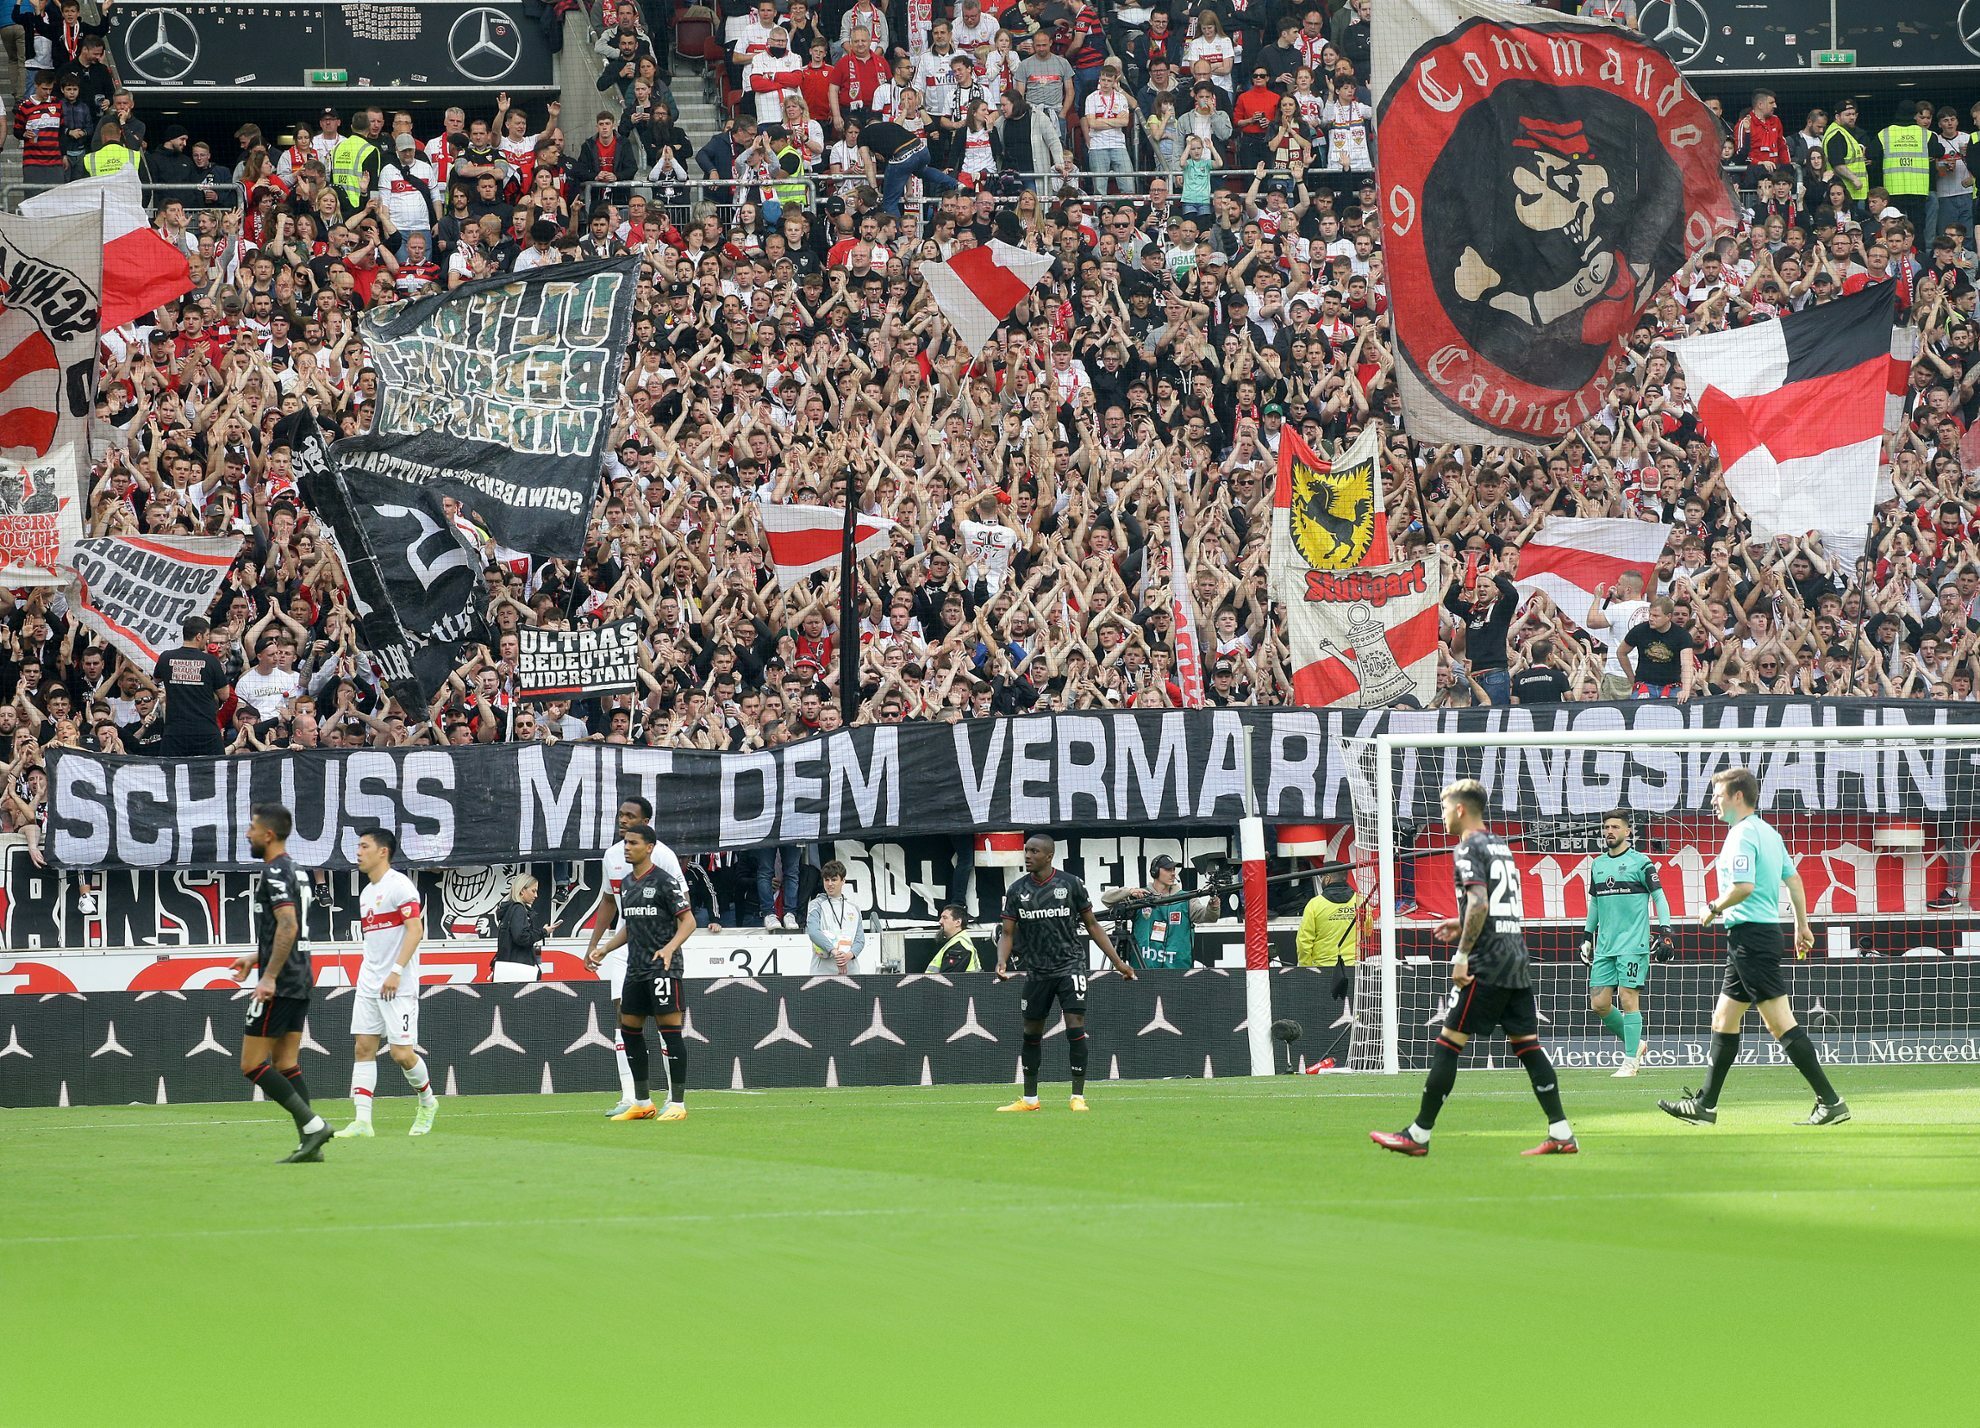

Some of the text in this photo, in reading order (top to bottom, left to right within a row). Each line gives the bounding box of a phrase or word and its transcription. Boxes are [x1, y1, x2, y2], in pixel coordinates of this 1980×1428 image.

[1417, 34, 1702, 148] Commando
[1900, 158, 1913, 167] 0331
[1171, 254, 1196, 266] OSAK
[520, 622, 638, 654] ULTRAS
[520, 645, 638, 672] BEDEUTET
[520, 663, 638, 688] WIDERSTAND
[1520, 674, 1553, 685] Commando
[54, 750, 456, 867] SCHLUSS
[518, 744, 674, 856] MIT
[719, 726, 900, 848] DEM
[1490, 859, 1520, 918] 25
[1018, 905, 1071, 919] Barmenia
[1141, 946, 1177, 964] HOST
[1626, 961, 1639, 978] 33
[654, 977, 672, 996] 21
[1071, 974, 1087, 992] 19
[402, 1014, 409, 1032] 3
[1869, 1038, 1980, 1063] Merced
